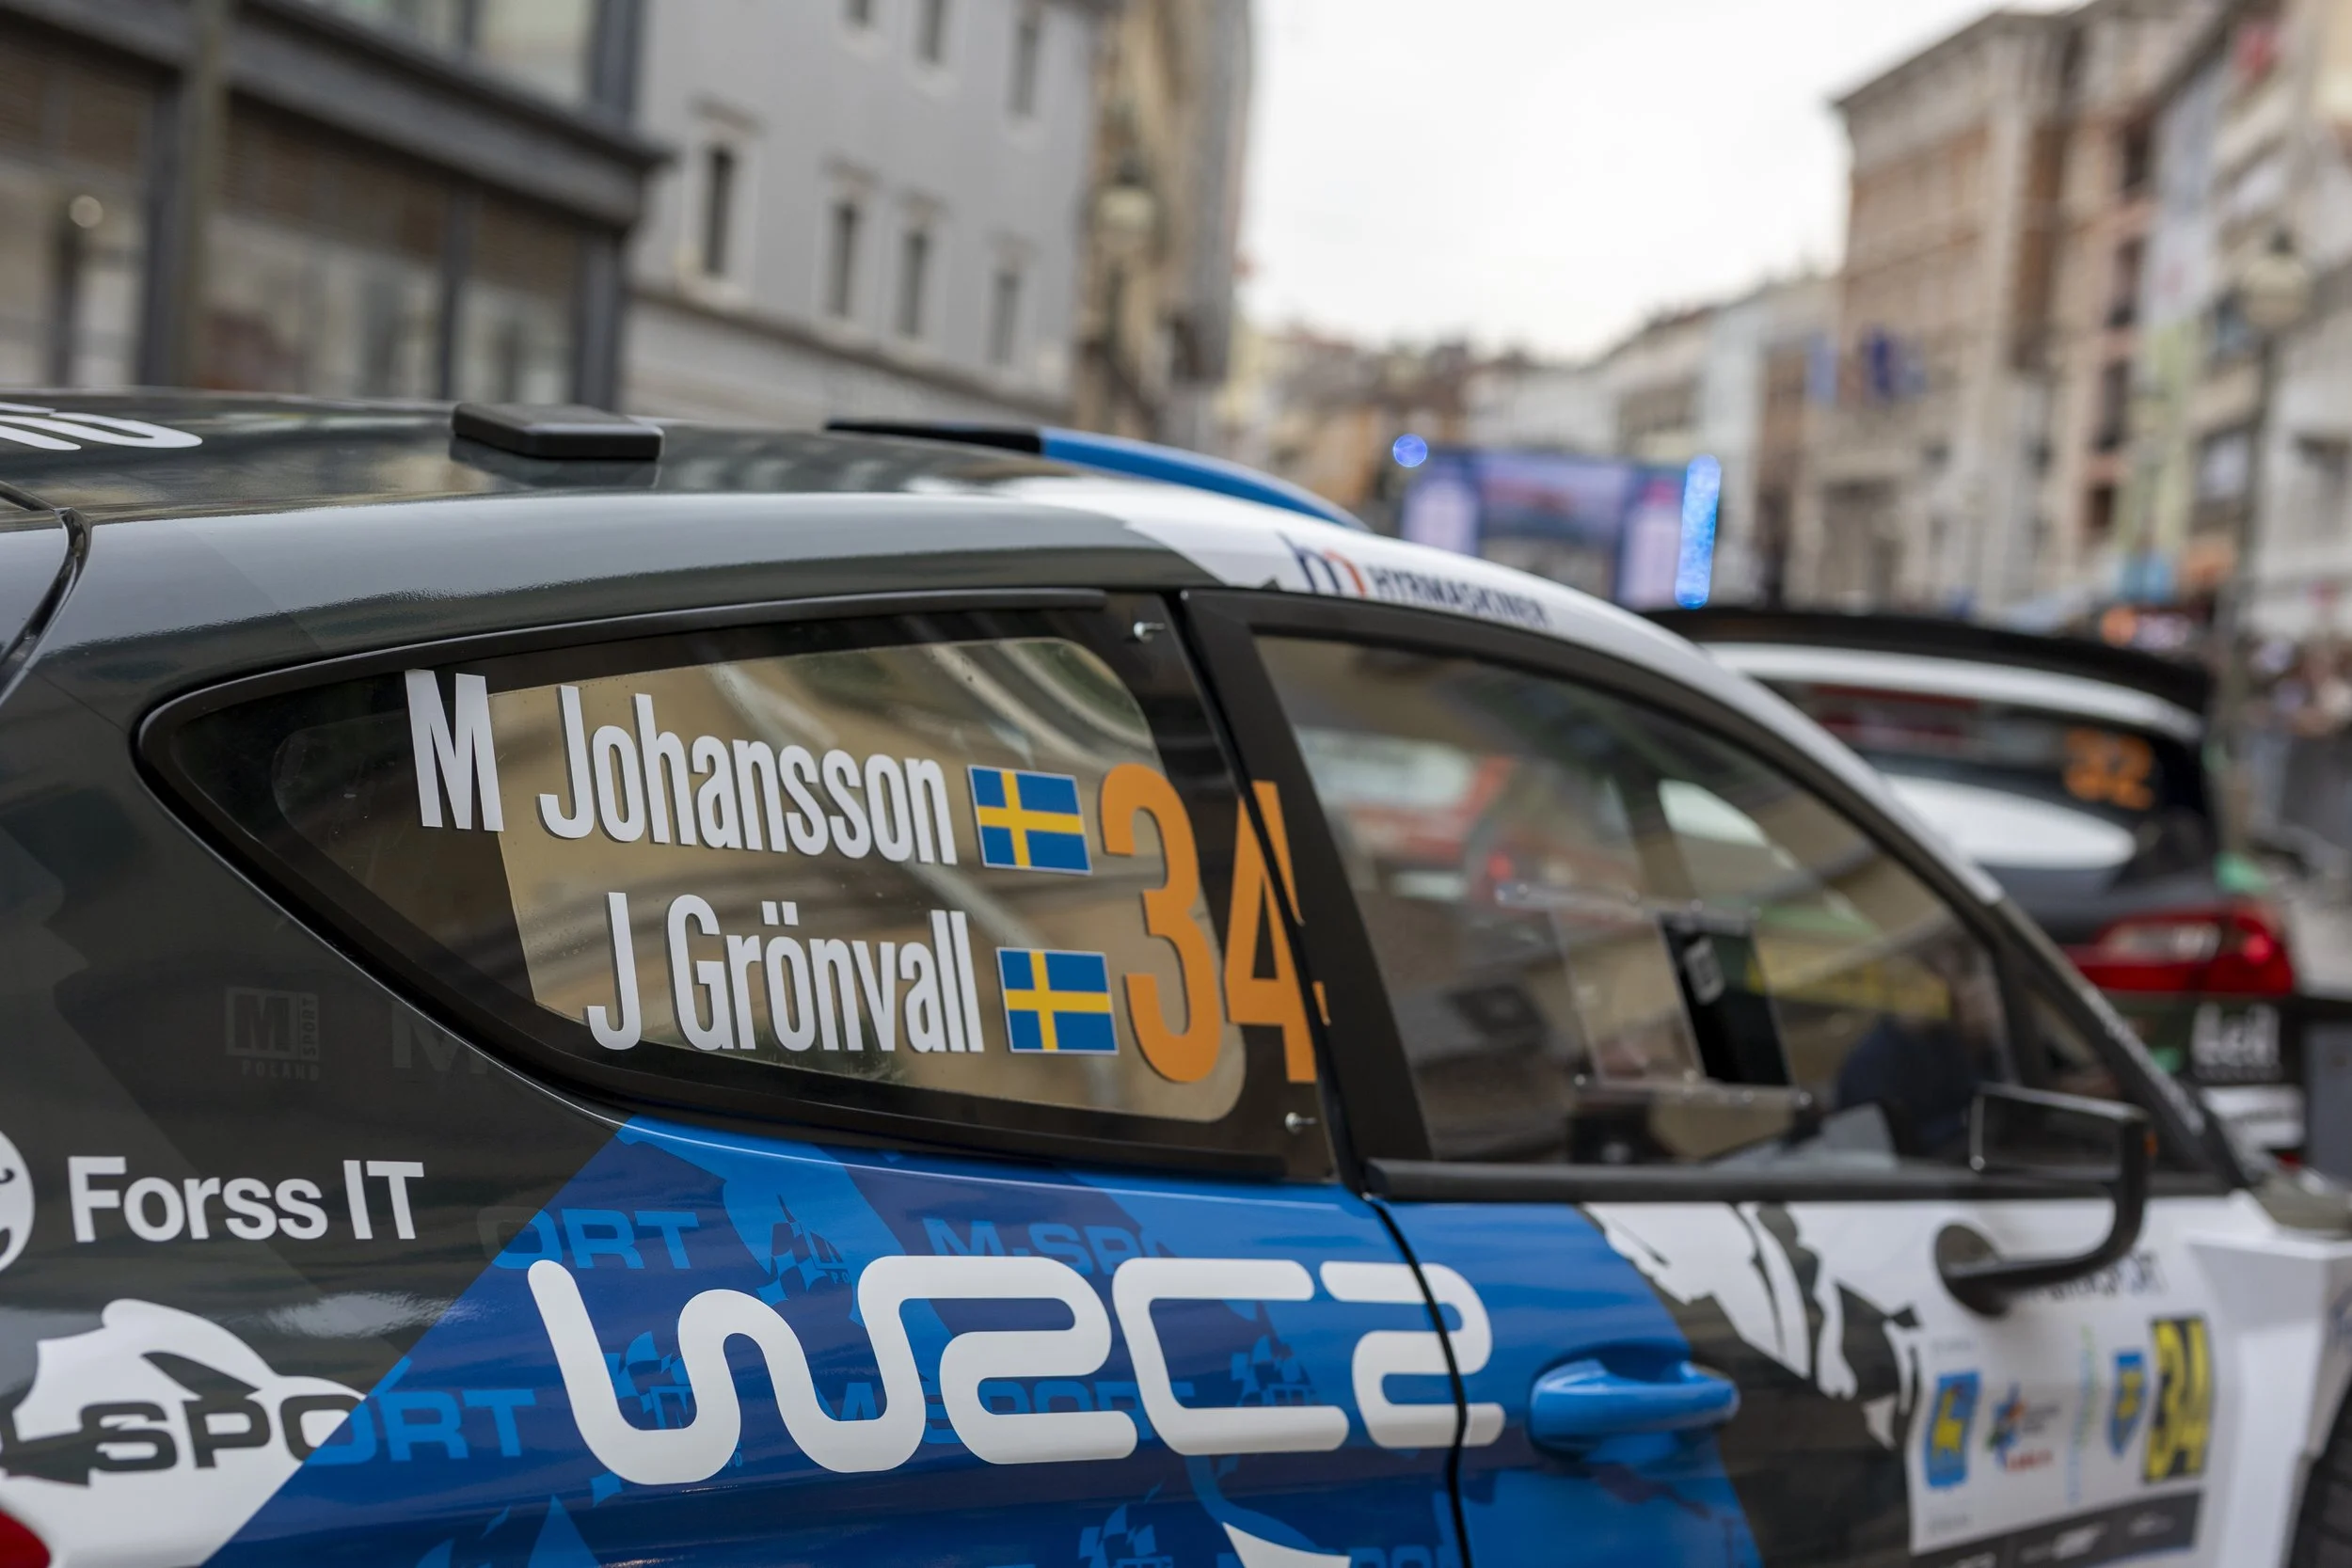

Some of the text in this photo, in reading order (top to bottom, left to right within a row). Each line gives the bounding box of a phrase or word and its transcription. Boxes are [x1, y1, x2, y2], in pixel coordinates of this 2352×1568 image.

[405, 668, 958, 866] M Johansson
[585, 892, 984, 1053] J Grönvall
[1099, 762, 1329, 1084] 34
[68, 1156, 328, 1243] Forss
[342, 1160, 425, 1240] IT
[528, 1255, 1505, 1485] WRC2
